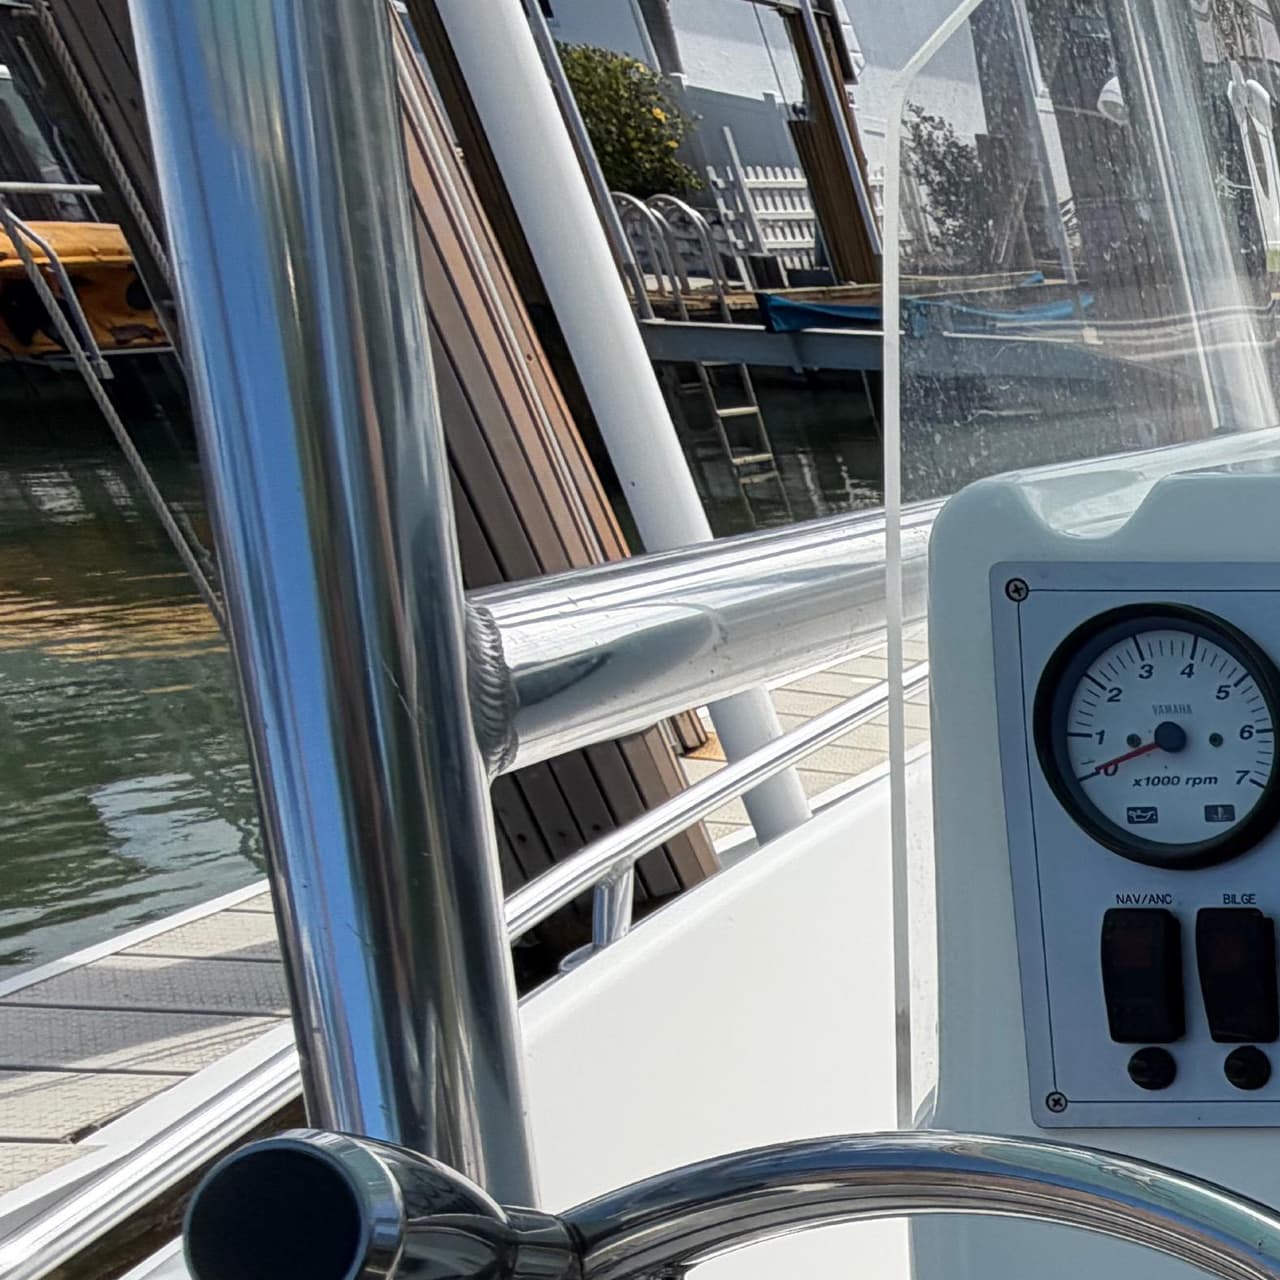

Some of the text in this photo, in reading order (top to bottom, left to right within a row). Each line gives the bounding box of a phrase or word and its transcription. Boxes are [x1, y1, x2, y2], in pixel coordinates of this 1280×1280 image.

[1138, 664, 1153, 679] 3
[1180, 664, 1195, 678] 4
[1107, 687, 1122, 702] 2
[1215, 684, 1231, 700] 5
[1152, 703, 1193, 715] YAMAHA
[1095, 729, 1105, 744] 1
[1240, 724, 1254, 740] 6
[1133, 776, 1219, 788] x1000 rpm
[1235, 770, 1250, 784] 7
[1116, 893, 1173, 905] NAV/ANC
[1223, 893, 1257, 905] BILGE
